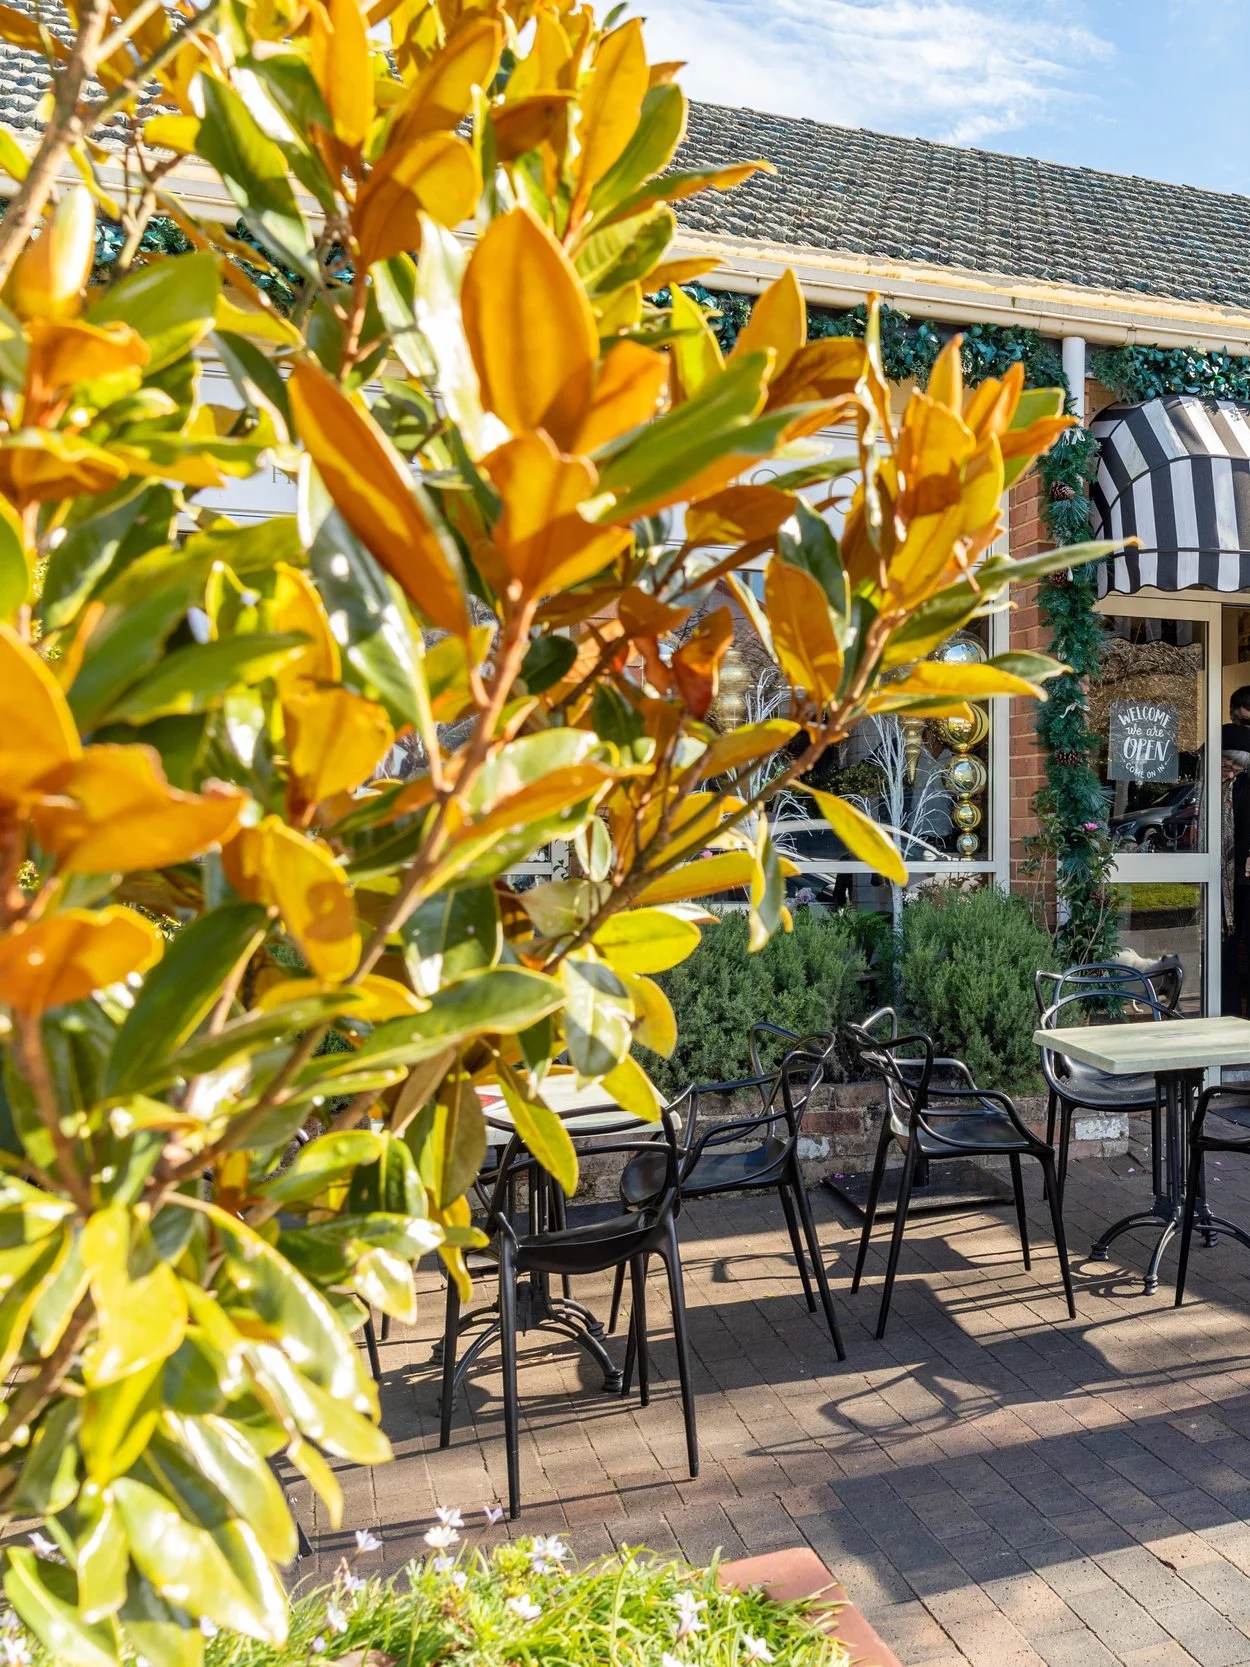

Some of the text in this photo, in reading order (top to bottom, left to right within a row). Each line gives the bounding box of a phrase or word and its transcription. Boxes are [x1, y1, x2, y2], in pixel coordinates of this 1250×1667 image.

[1117, 705, 1172, 729] WELCOME
[1126, 723, 1165, 738] we are
[1123, 736, 1171, 762] OPEN
[1125, 762, 1166, 779] COME ON IN
